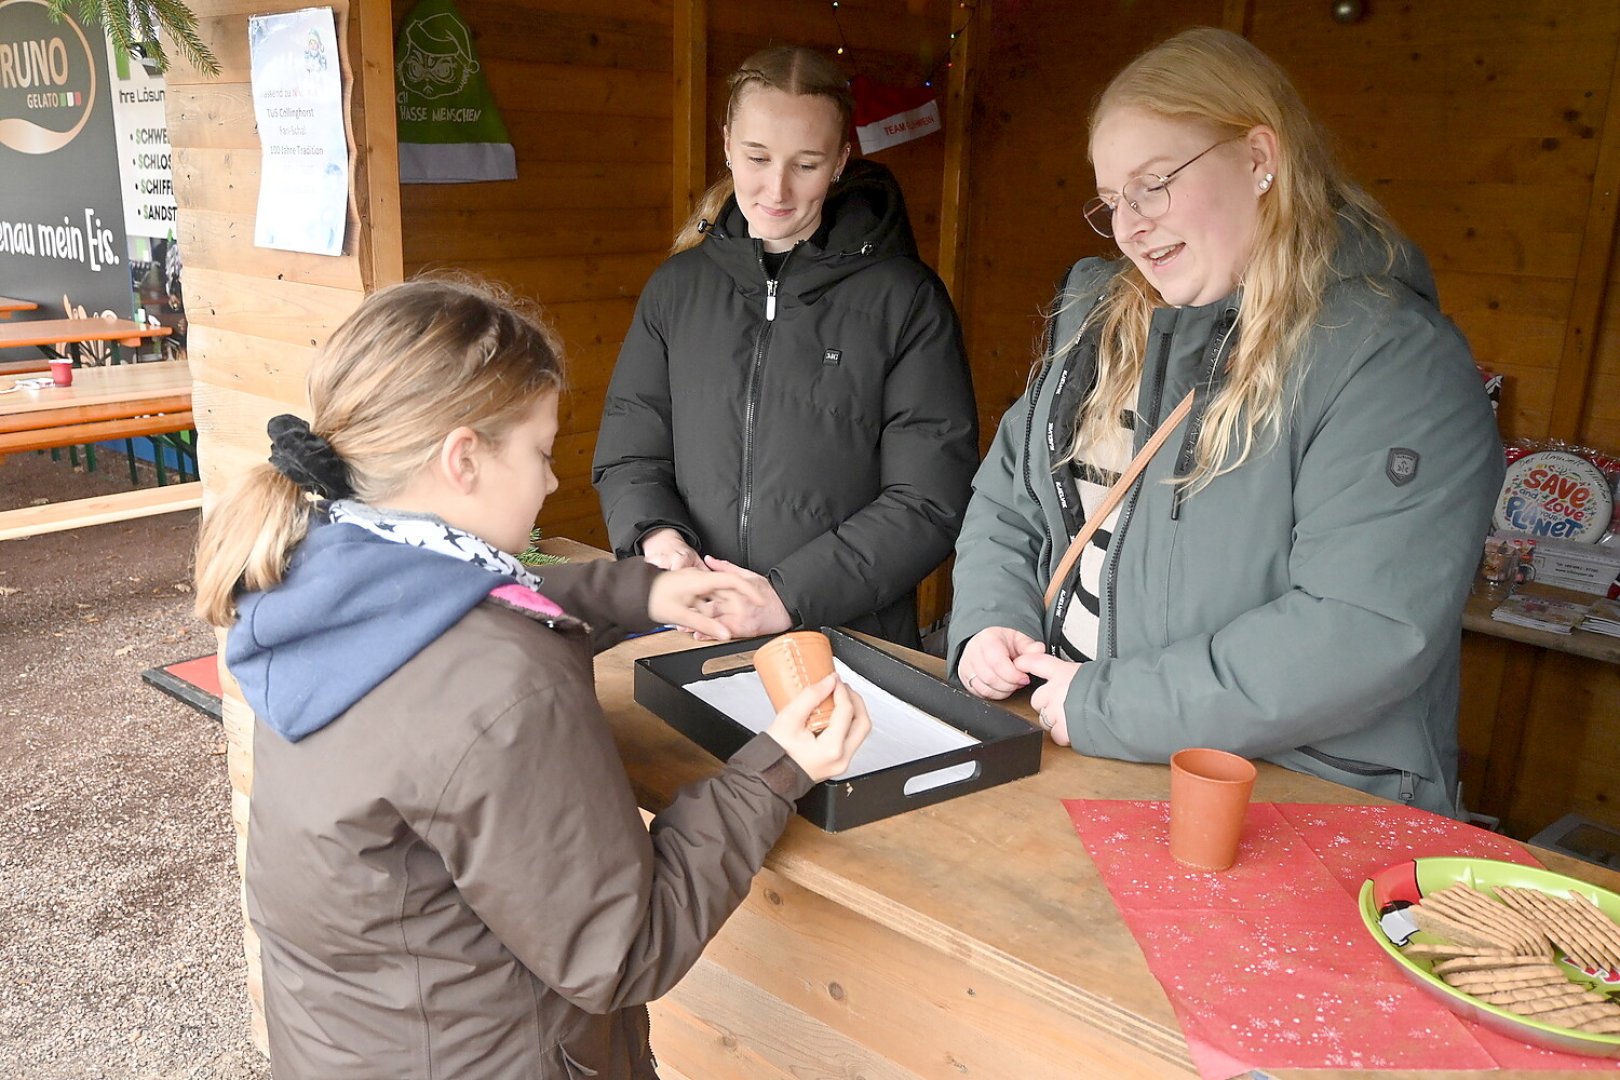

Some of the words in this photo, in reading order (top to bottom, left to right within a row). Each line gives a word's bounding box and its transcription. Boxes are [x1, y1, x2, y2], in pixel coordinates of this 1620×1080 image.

[27, 92, 59, 109] GELATO
[119, 90, 135, 103] Ihre
[396, 90, 409, 104] CH
[279, 106, 315, 120] Collinghorst
[400, 106, 428, 121] HASSE
[432, 107, 481, 122] MENSCHEN
[884, 121, 906, 136] TEAM
[270, 145, 281, 156] 100
[296, 144, 324, 156] Tradition
[143, 205, 177, 221] SANDST
[38, 216, 84, 263] mein
[85, 207, 119, 271] Eis.
[1055, 481, 1068, 509] KJELVIK
[1519, 488, 1539, 500] and
[1055, 589, 1067, 618] KJELVIK
